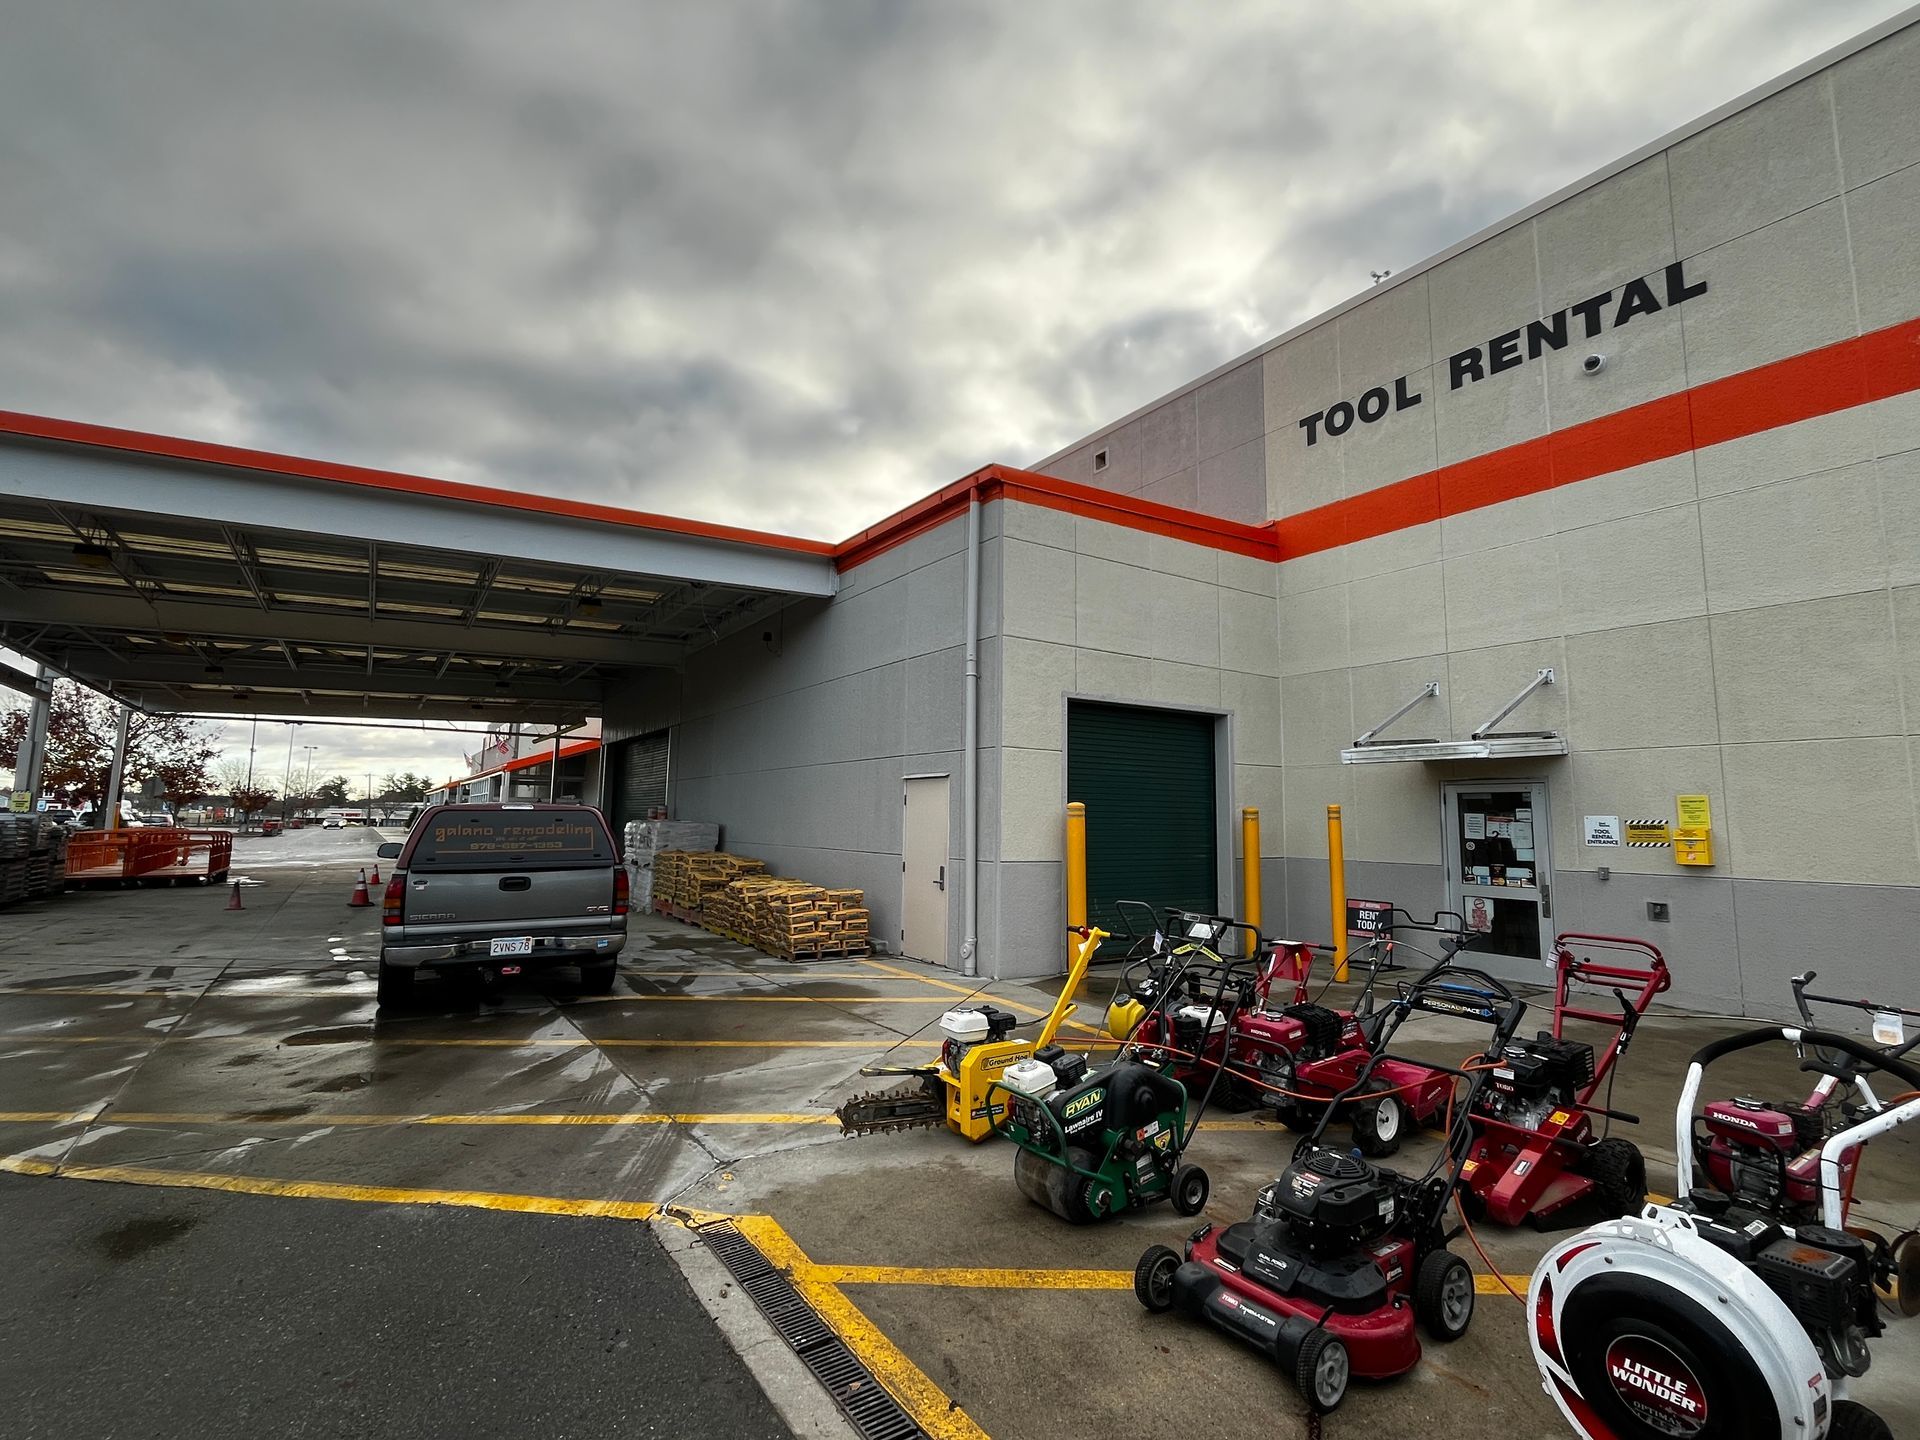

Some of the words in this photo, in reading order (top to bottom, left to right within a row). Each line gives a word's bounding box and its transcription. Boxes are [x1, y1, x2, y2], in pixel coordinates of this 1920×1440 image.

[1299, 376, 1422, 447] TOOL
[1449, 261, 1707, 390] RENTAL
[409, 913, 456, 921] SIERRA
[1359, 910, 1379, 920] RENT
[1423, 999, 1461, 1011] PERSONAL
[1462, 1006, 1480, 1015] PACE
[1250, 1028, 1271, 1038] HONDA
[988, 1055, 1014, 1066] Ground
[1495, 1082, 1514, 1092] TORO
[1065, 1090, 1102, 1118] RYAN
[1713, 1112, 1758, 1129] HONDA
[1222, 1293, 1239, 1306] TORO
[1623, 1357, 1688, 1395] LITTLE
[1612, 1365, 1696, 1413] WONDER
